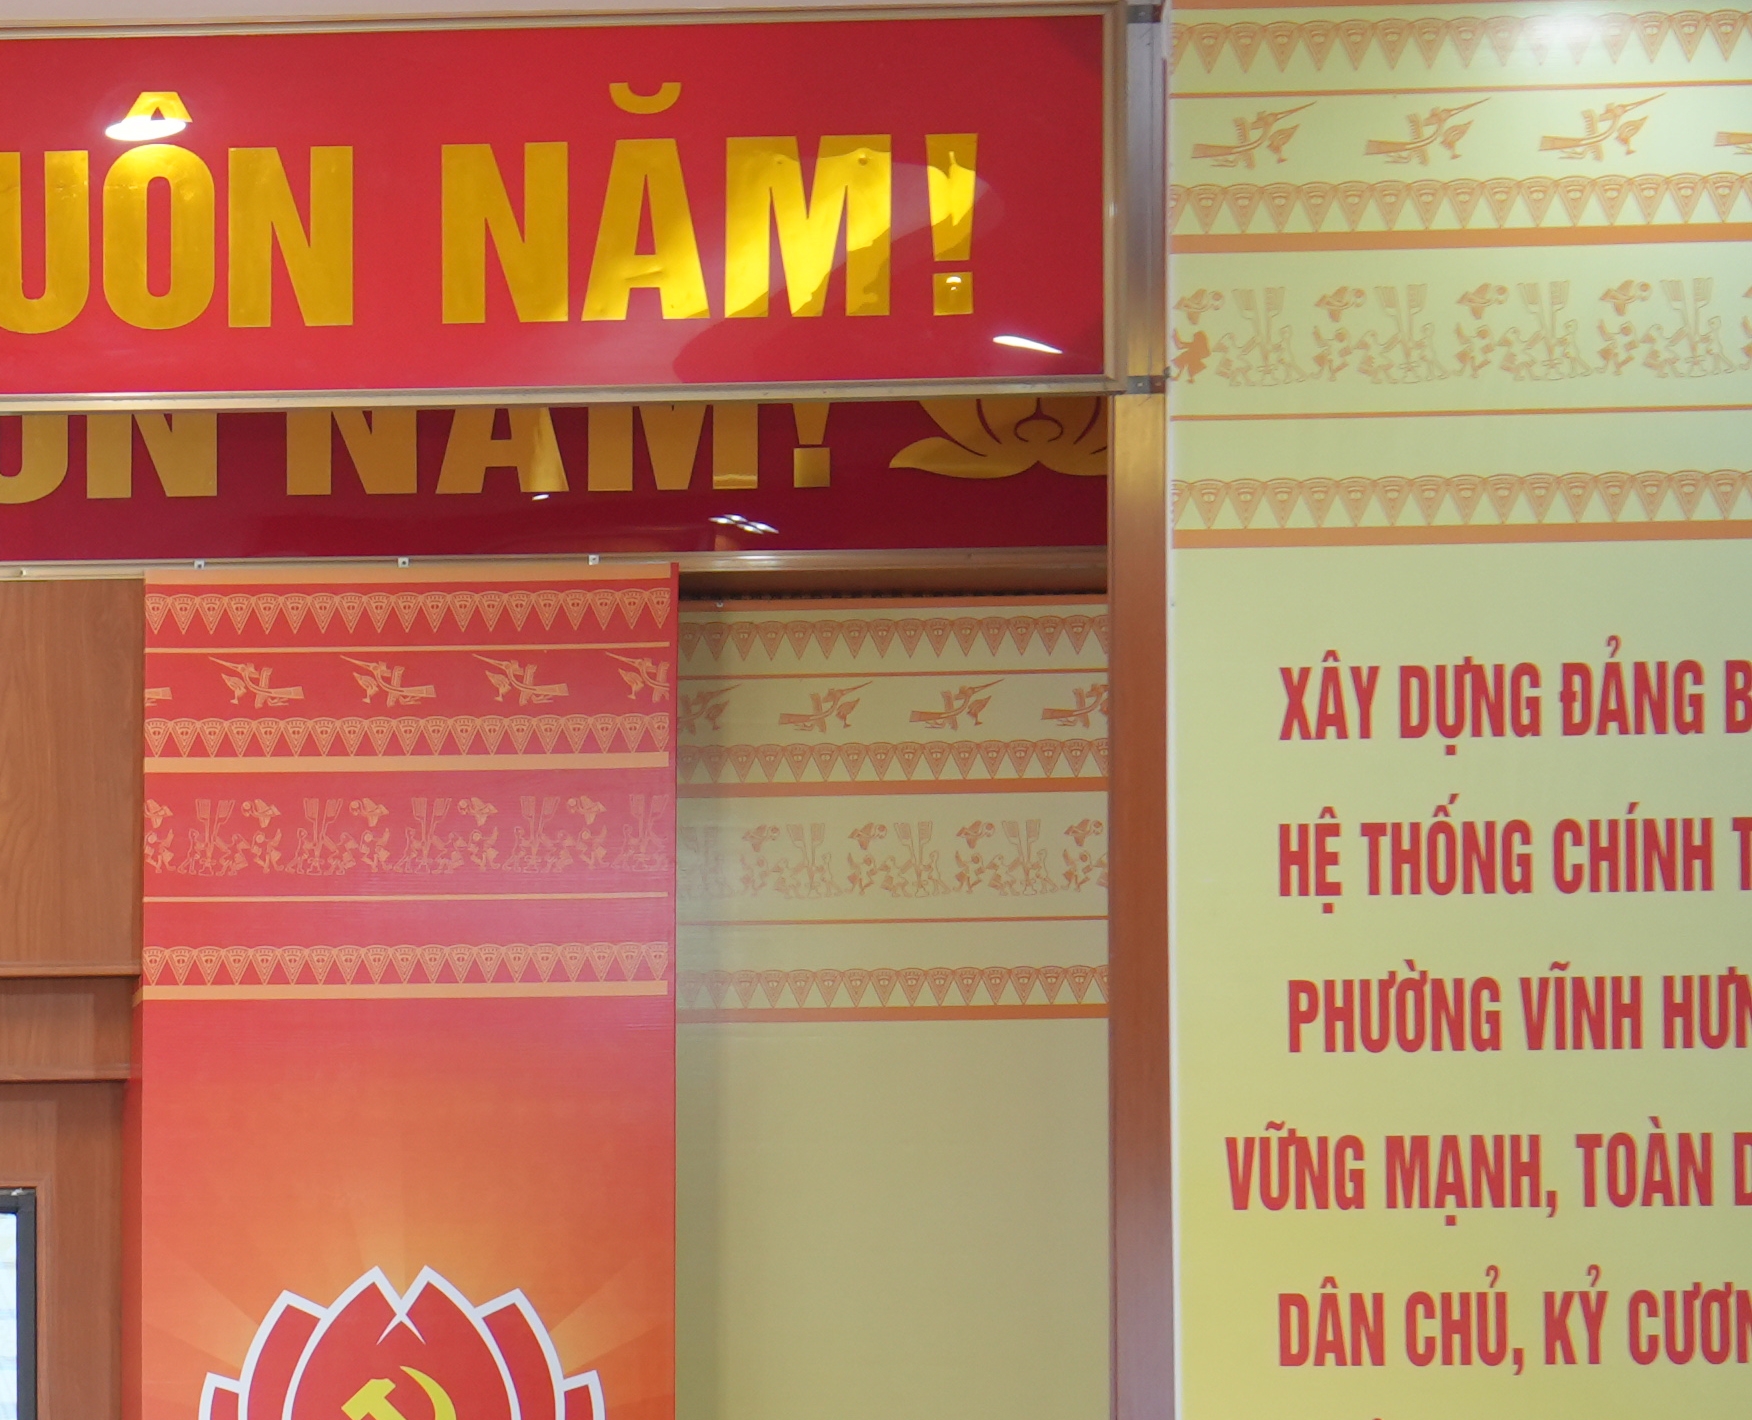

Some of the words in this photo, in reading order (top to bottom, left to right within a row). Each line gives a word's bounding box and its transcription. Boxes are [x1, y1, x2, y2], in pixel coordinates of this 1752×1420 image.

[440, 82, 979, 326] NĂM!
[1280, 649, 1380, 741] XÂY
[1399, 656, 1542, 756] DỰNG
[1559, 635, 1705, 737] ĐẢNG
[1279, 806, 1343, 914] HỆ
[1360, 793, 1533, 896] THỐNG
[1553, 801, 1714, 894] CHÍNH
[1288, 959, 1502, 1053] PHƯỜNG
[1520, 961, 1643, 1051] VĨNH
[1225, 1121, 1366, 1211] VỮNG
[1385, 1134, 1559, 1226] MẠNH,
[1575, 1116, 1714, 1208] TOÀN
[1279, 1275, 1386, 1367] DÂN
[1405, 1265, 1525, 1375] CHỦ,
[1544, 1264, 1609, 1366] KỶ
